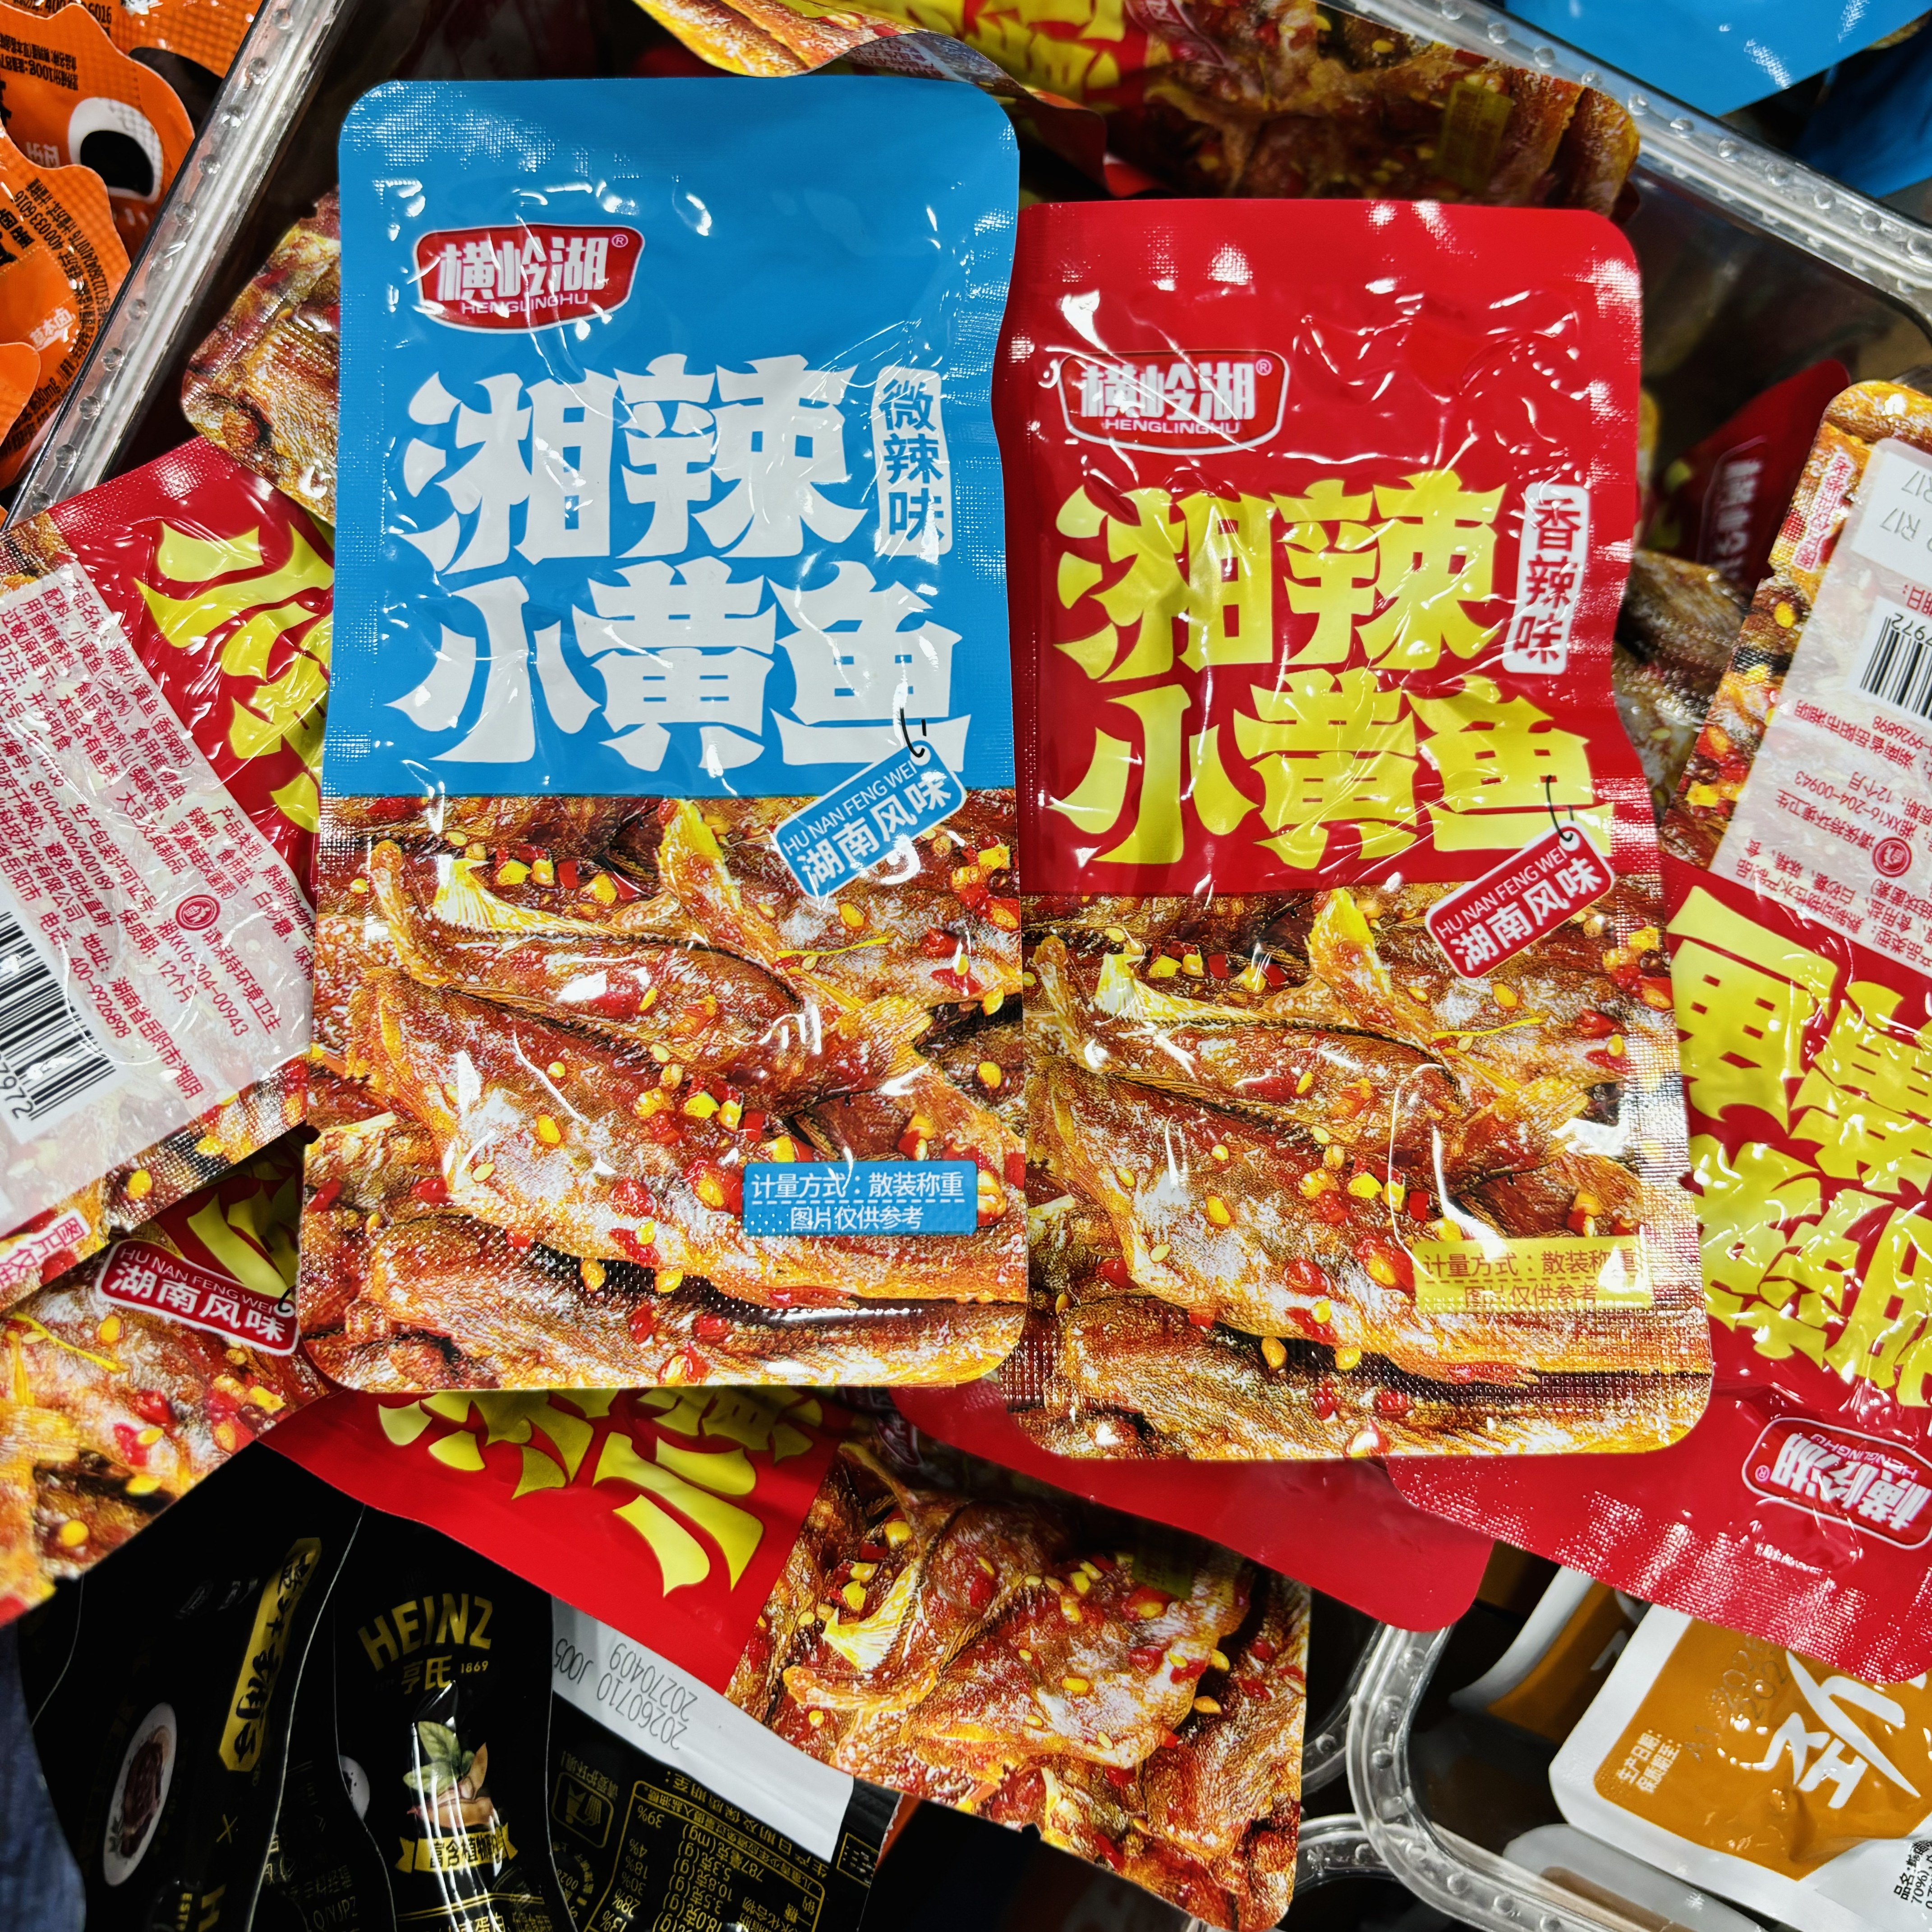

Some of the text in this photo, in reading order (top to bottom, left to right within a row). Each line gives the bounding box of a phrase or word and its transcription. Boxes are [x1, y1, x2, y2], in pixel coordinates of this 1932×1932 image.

[435, 237, 610, 303] 横岭湖
[460, 292, 589, 316] HENGLINGHU
[1081, 362, 1256, 423] 横岭湖
[1105, 419, 1240, 435] HENGLINGHU
[396, 354, 867, 575] 湘辣
[882, 377, 944, 542] 微辣味
[1878, 506, 1921, 543] R17
[1053, 469, 1506, 683] 湘辣
[1510, 488, 1583, 665] 香辣味
[384, 557, 971, 772] 小黄鱼
[1047, 667, 1615, 869] 小黄鱼
[782, 760, 918, 856] HU NAN FENG WEI
[796, 772, 951, 888] 湖南风味
[1771, 788, 1877, 850] 请保持环境卫生
[1436, 846, 1568, 939] HU NAN FENG WEI
[1450, 858, 1601, 971] 湖南风味
[115, 906, 198, 1005] 保质期：12个月
[200, 925, 285, 1035] 请保持环境卫生
[752, 1173, 964, 1198] 计量方式：散装称重
[791, 1205, 923, 1230] 图片仅供参考
[110, 1263, 287, 1343] 湖南风味
[120, 1247, 274, 1315] HU NAN FENG WEI
[1769, 1432, 1932, 1532] 横岭湖
[358, 1593, 493, 1670] HEINZ
[400, 1654, 489, 1695] 亨氏 1869
[591, 1671, 688, 1752] 20260710
[604, 1641, 699, 1723] 20270409
[1615, 1729, 1662, 1785] 生产日期：
[1634, 1738, 1682, 1794] 保质期至：
[626, 1837, 649, 1858] 4%
[635, 1803, 665, 1829] 39%
[617, 1871, 647, 1895] 30%
[621, 1854, 651, 1879] 18%
